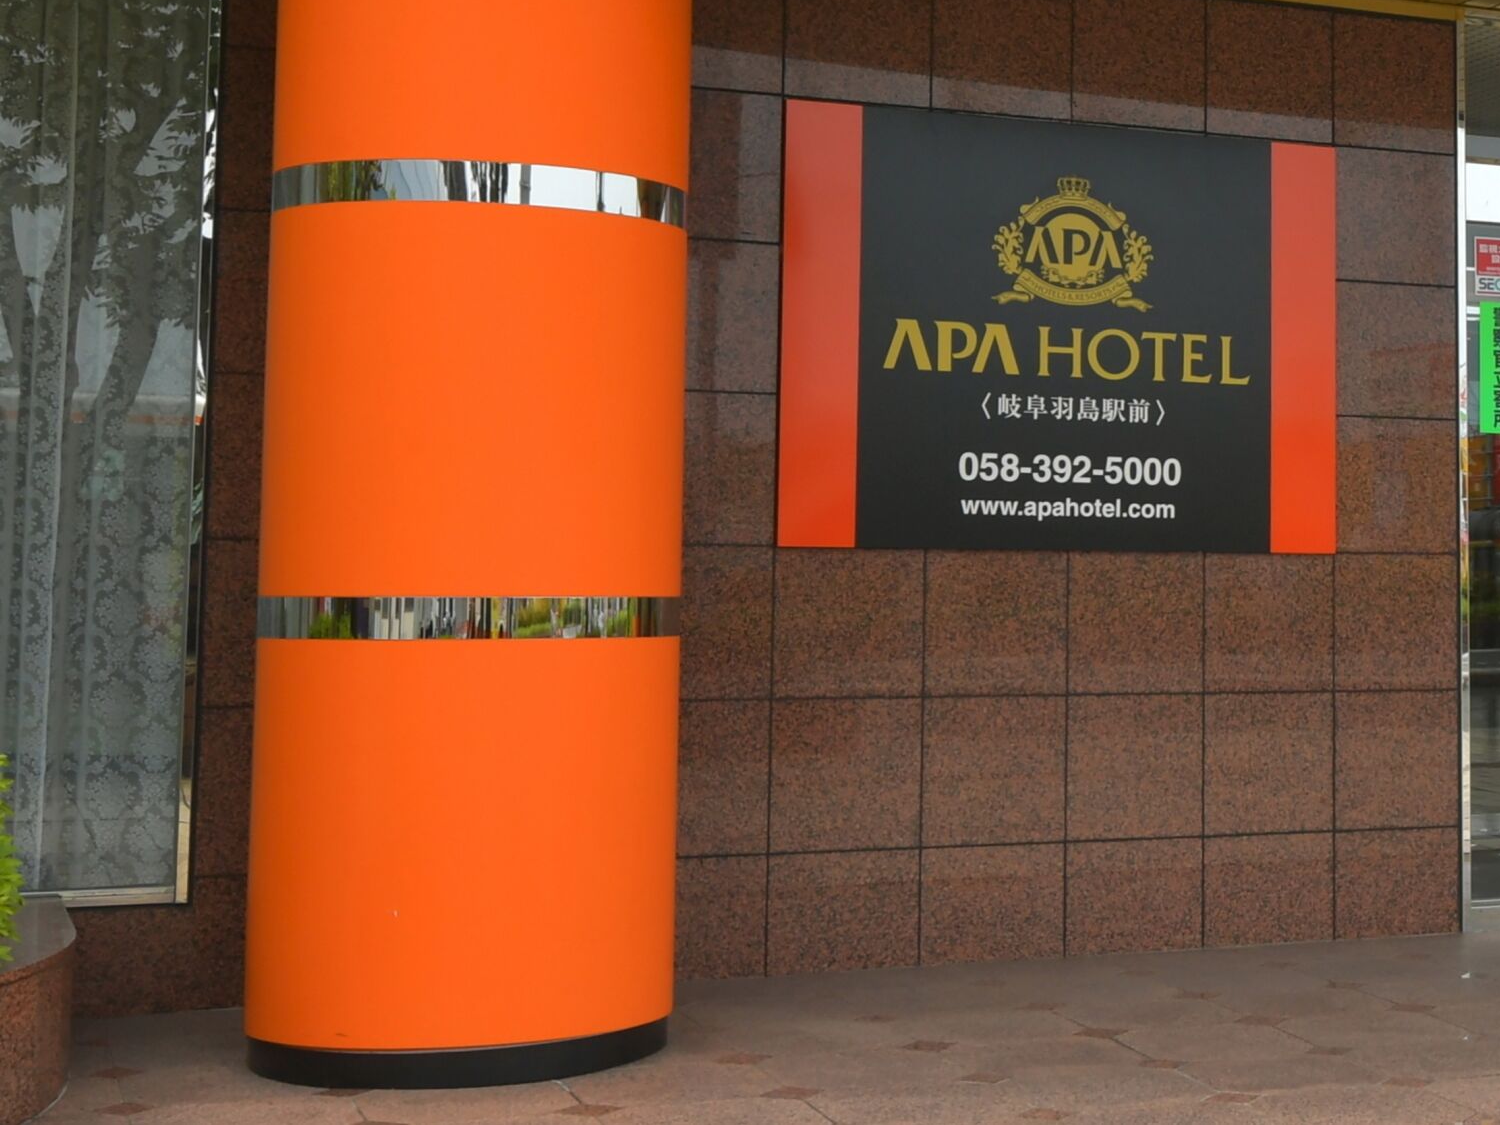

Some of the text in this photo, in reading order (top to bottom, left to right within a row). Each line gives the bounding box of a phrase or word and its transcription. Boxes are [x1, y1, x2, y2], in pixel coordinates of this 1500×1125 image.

[1026, 226, 1123, 269] APA
[883, 318, 1250, 386] APA HOTEL
[958, 452, 1181, 486] 058-392-5000
[961, 499, 1176, 521] www.apahotel.com
